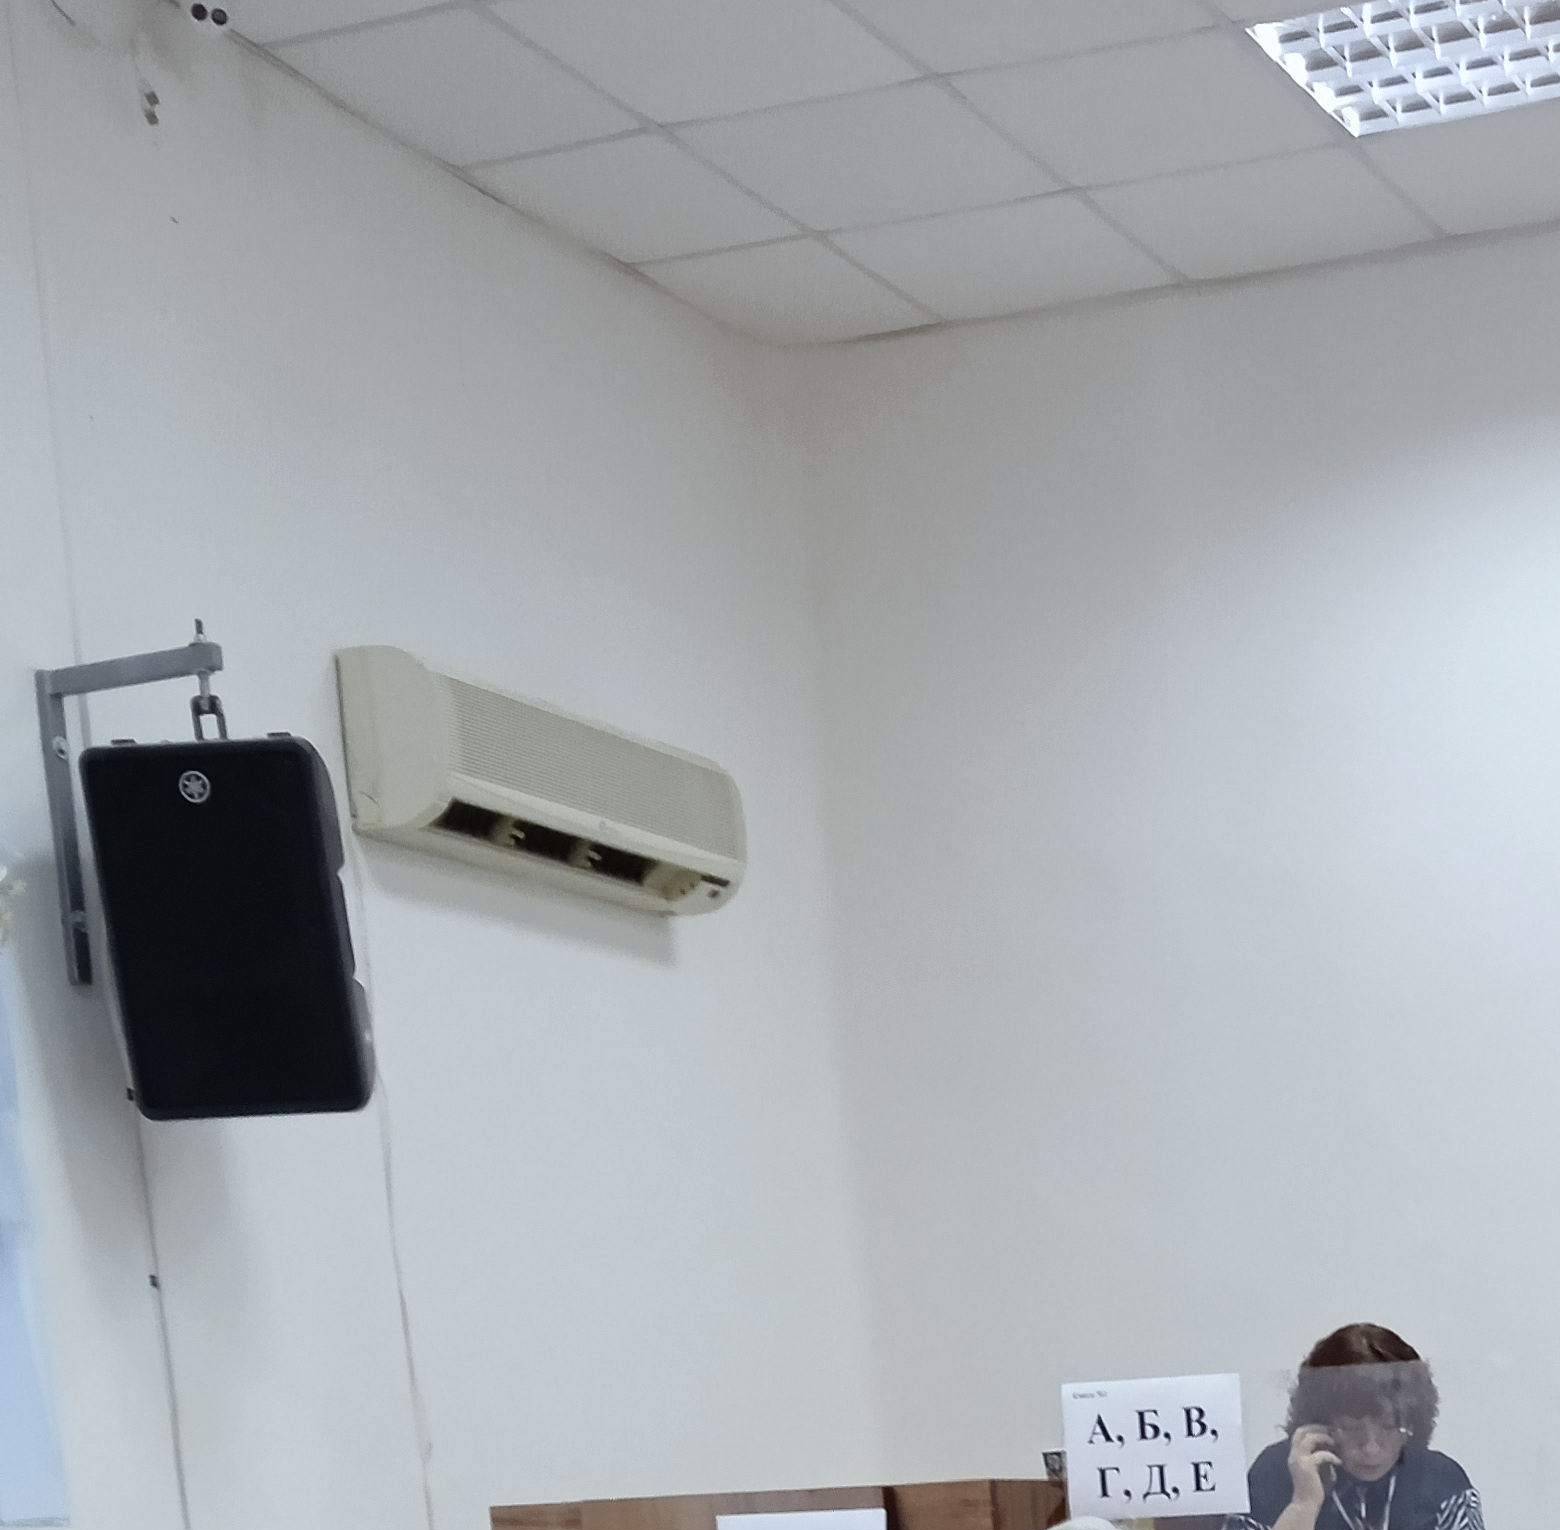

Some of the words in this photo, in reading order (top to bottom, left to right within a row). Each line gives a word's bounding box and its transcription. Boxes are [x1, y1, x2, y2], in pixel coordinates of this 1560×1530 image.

[1087, 1413, 1125, 1448] А,
[1135, 1409, 1172, 1446] Б,
[1182, 1406, 1219, 1443] В,
[1097, 1467, 1132, 1503] Г,
[1142, 1464, 1180, 1503] Д,
[1190, 1461, 1216, 1493] Е
